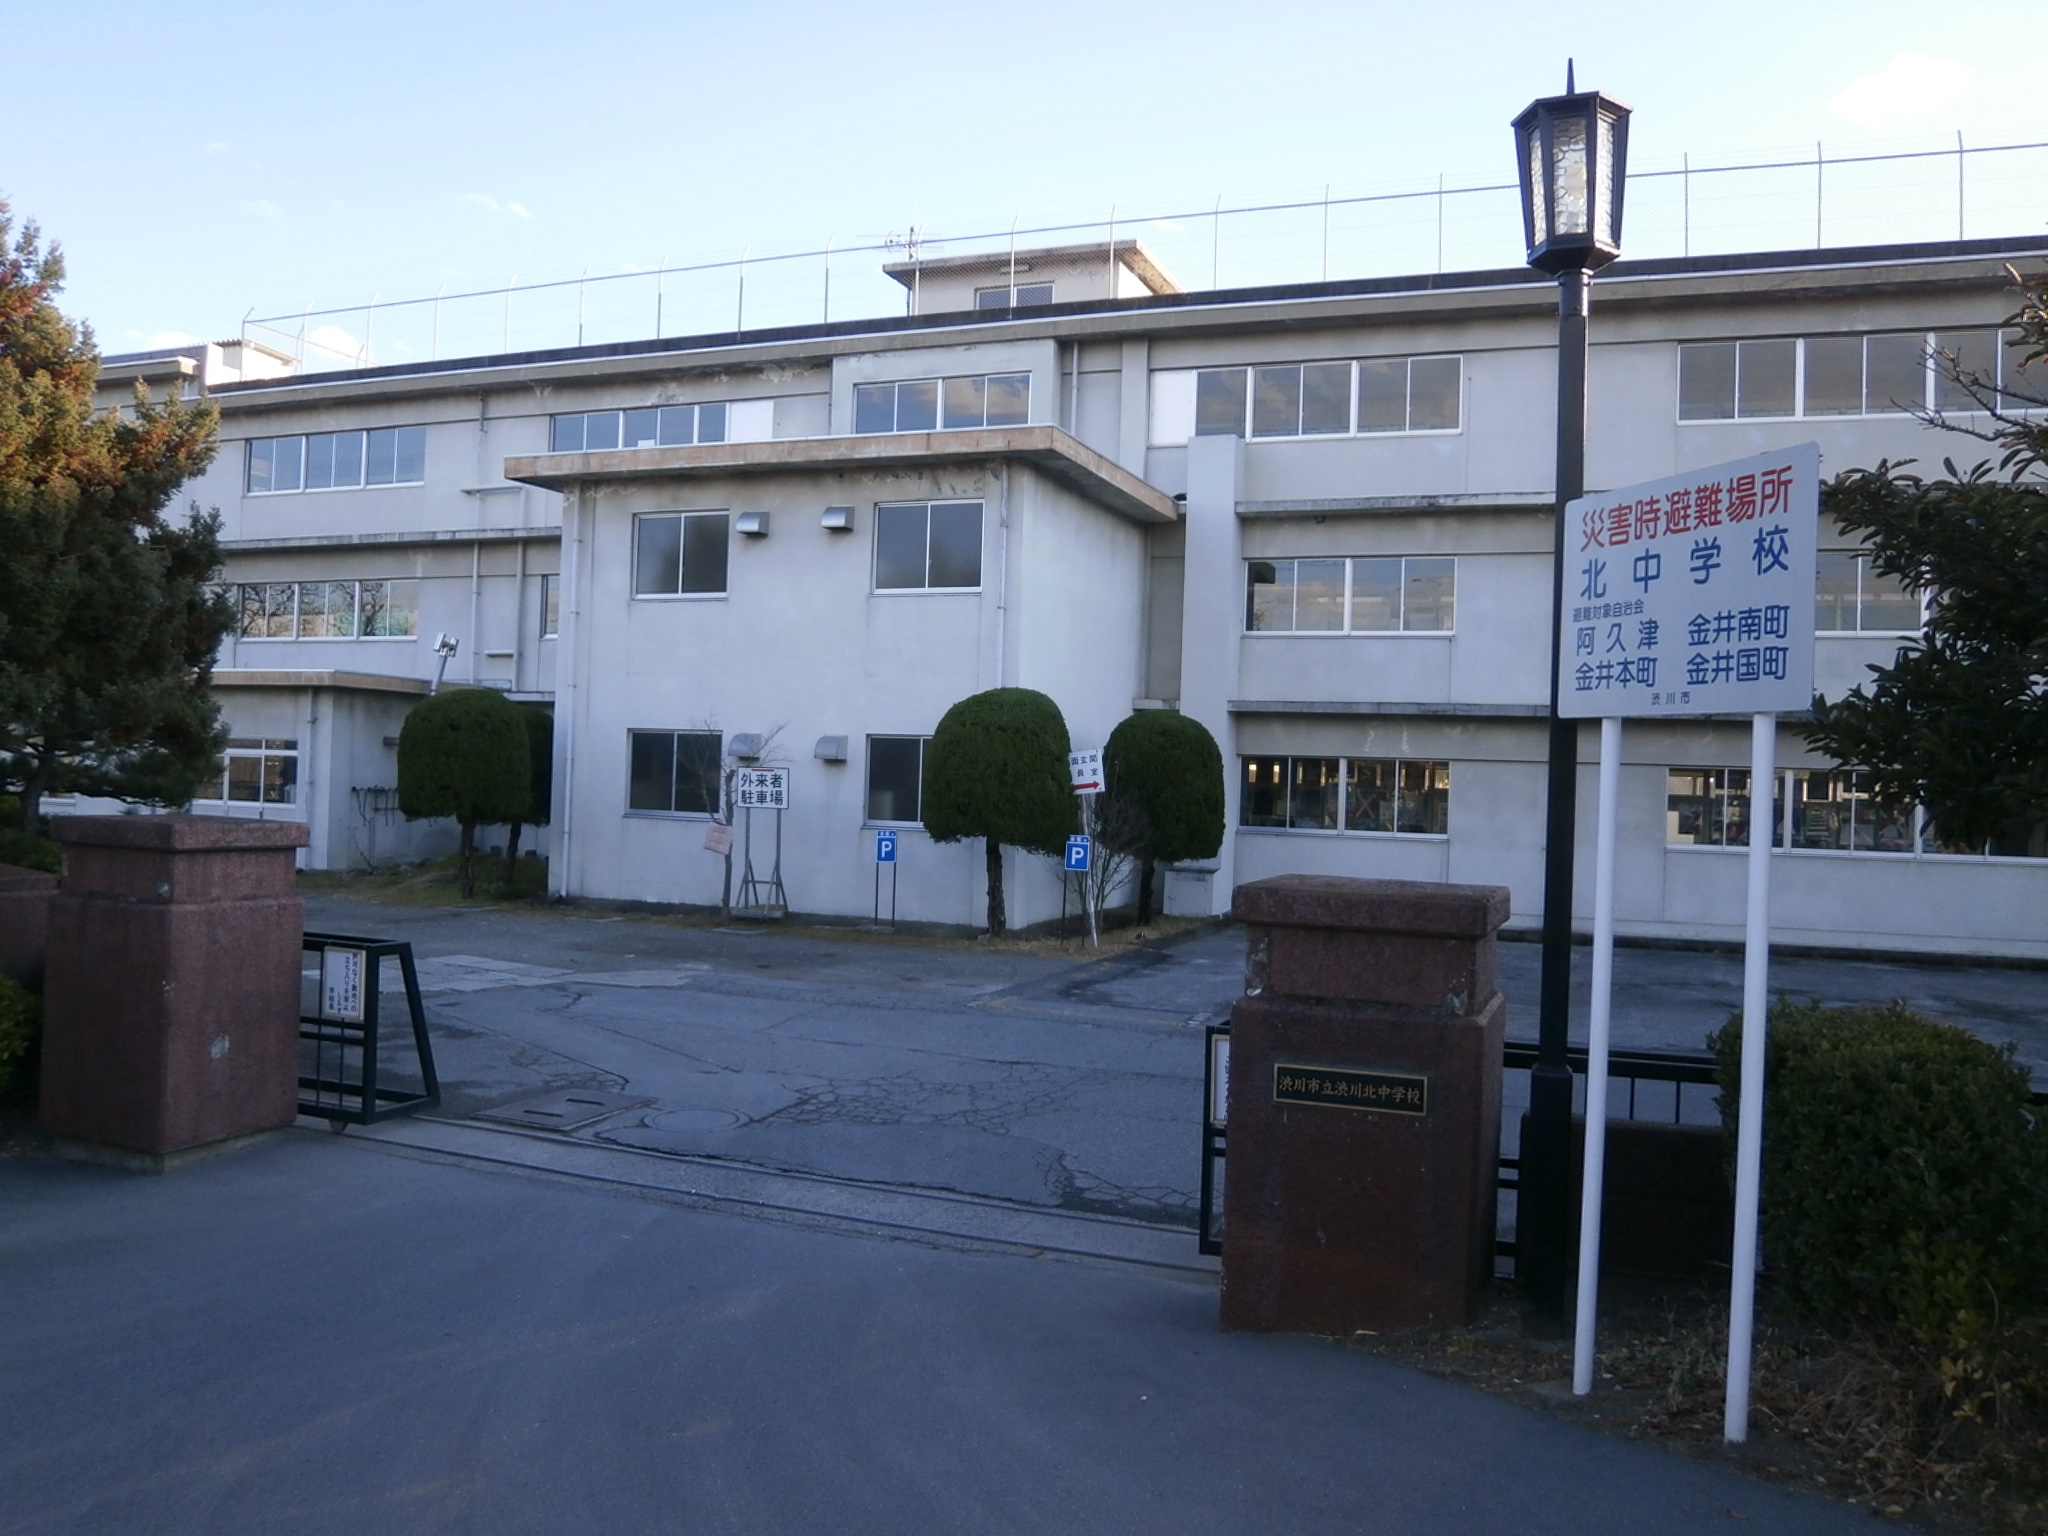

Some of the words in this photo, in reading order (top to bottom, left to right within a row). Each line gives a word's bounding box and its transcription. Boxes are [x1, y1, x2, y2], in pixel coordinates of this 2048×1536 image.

[1581, 465, 1793, 552] 災害時避難場所
[1580, 524, 1789, 601] 北中学校
[1572, 598, 1645, 623] 避難対象自治会
[1688, 604, 1790, 647] 金井南町
[1577, 618, 1660, 656] 阿久津
[1575, 657, 1658, 691] 金井本町
[1686, 646, 1789, 686] 金井国町
[740, 772, 784, 789] 外来者
[741, 789, 784, 806] 駐車場
[881, 840, 893, 858] P
[1070, 846, 1085, 865] P
[1278, 1075, 1421, 1105] 渋川市立渋川北中学校
